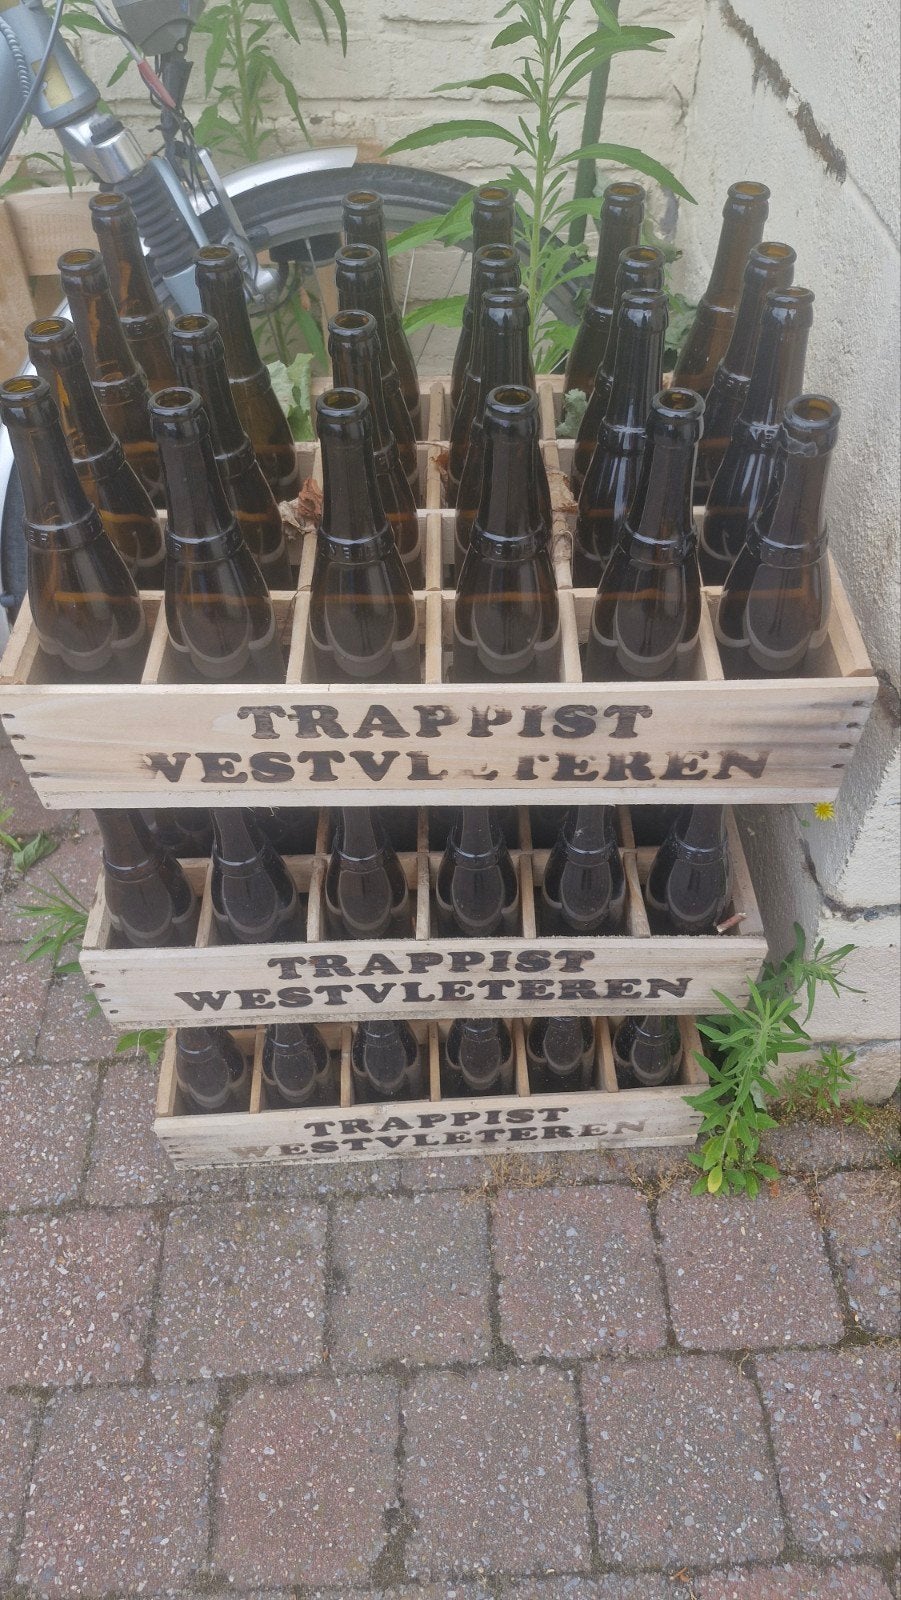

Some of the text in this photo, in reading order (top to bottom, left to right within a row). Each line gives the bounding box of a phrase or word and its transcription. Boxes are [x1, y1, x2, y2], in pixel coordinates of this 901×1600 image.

[237, 704, 653, 739] TRAPPIST
[267, 949, 596, 980] TRAPPIST
[174, 977, 694, 1012] WESTVLETEREN
[228, 1119, 648, 1158] WESTVLETEREN
[303, 1107, 570, 1137] TRAPPIST
